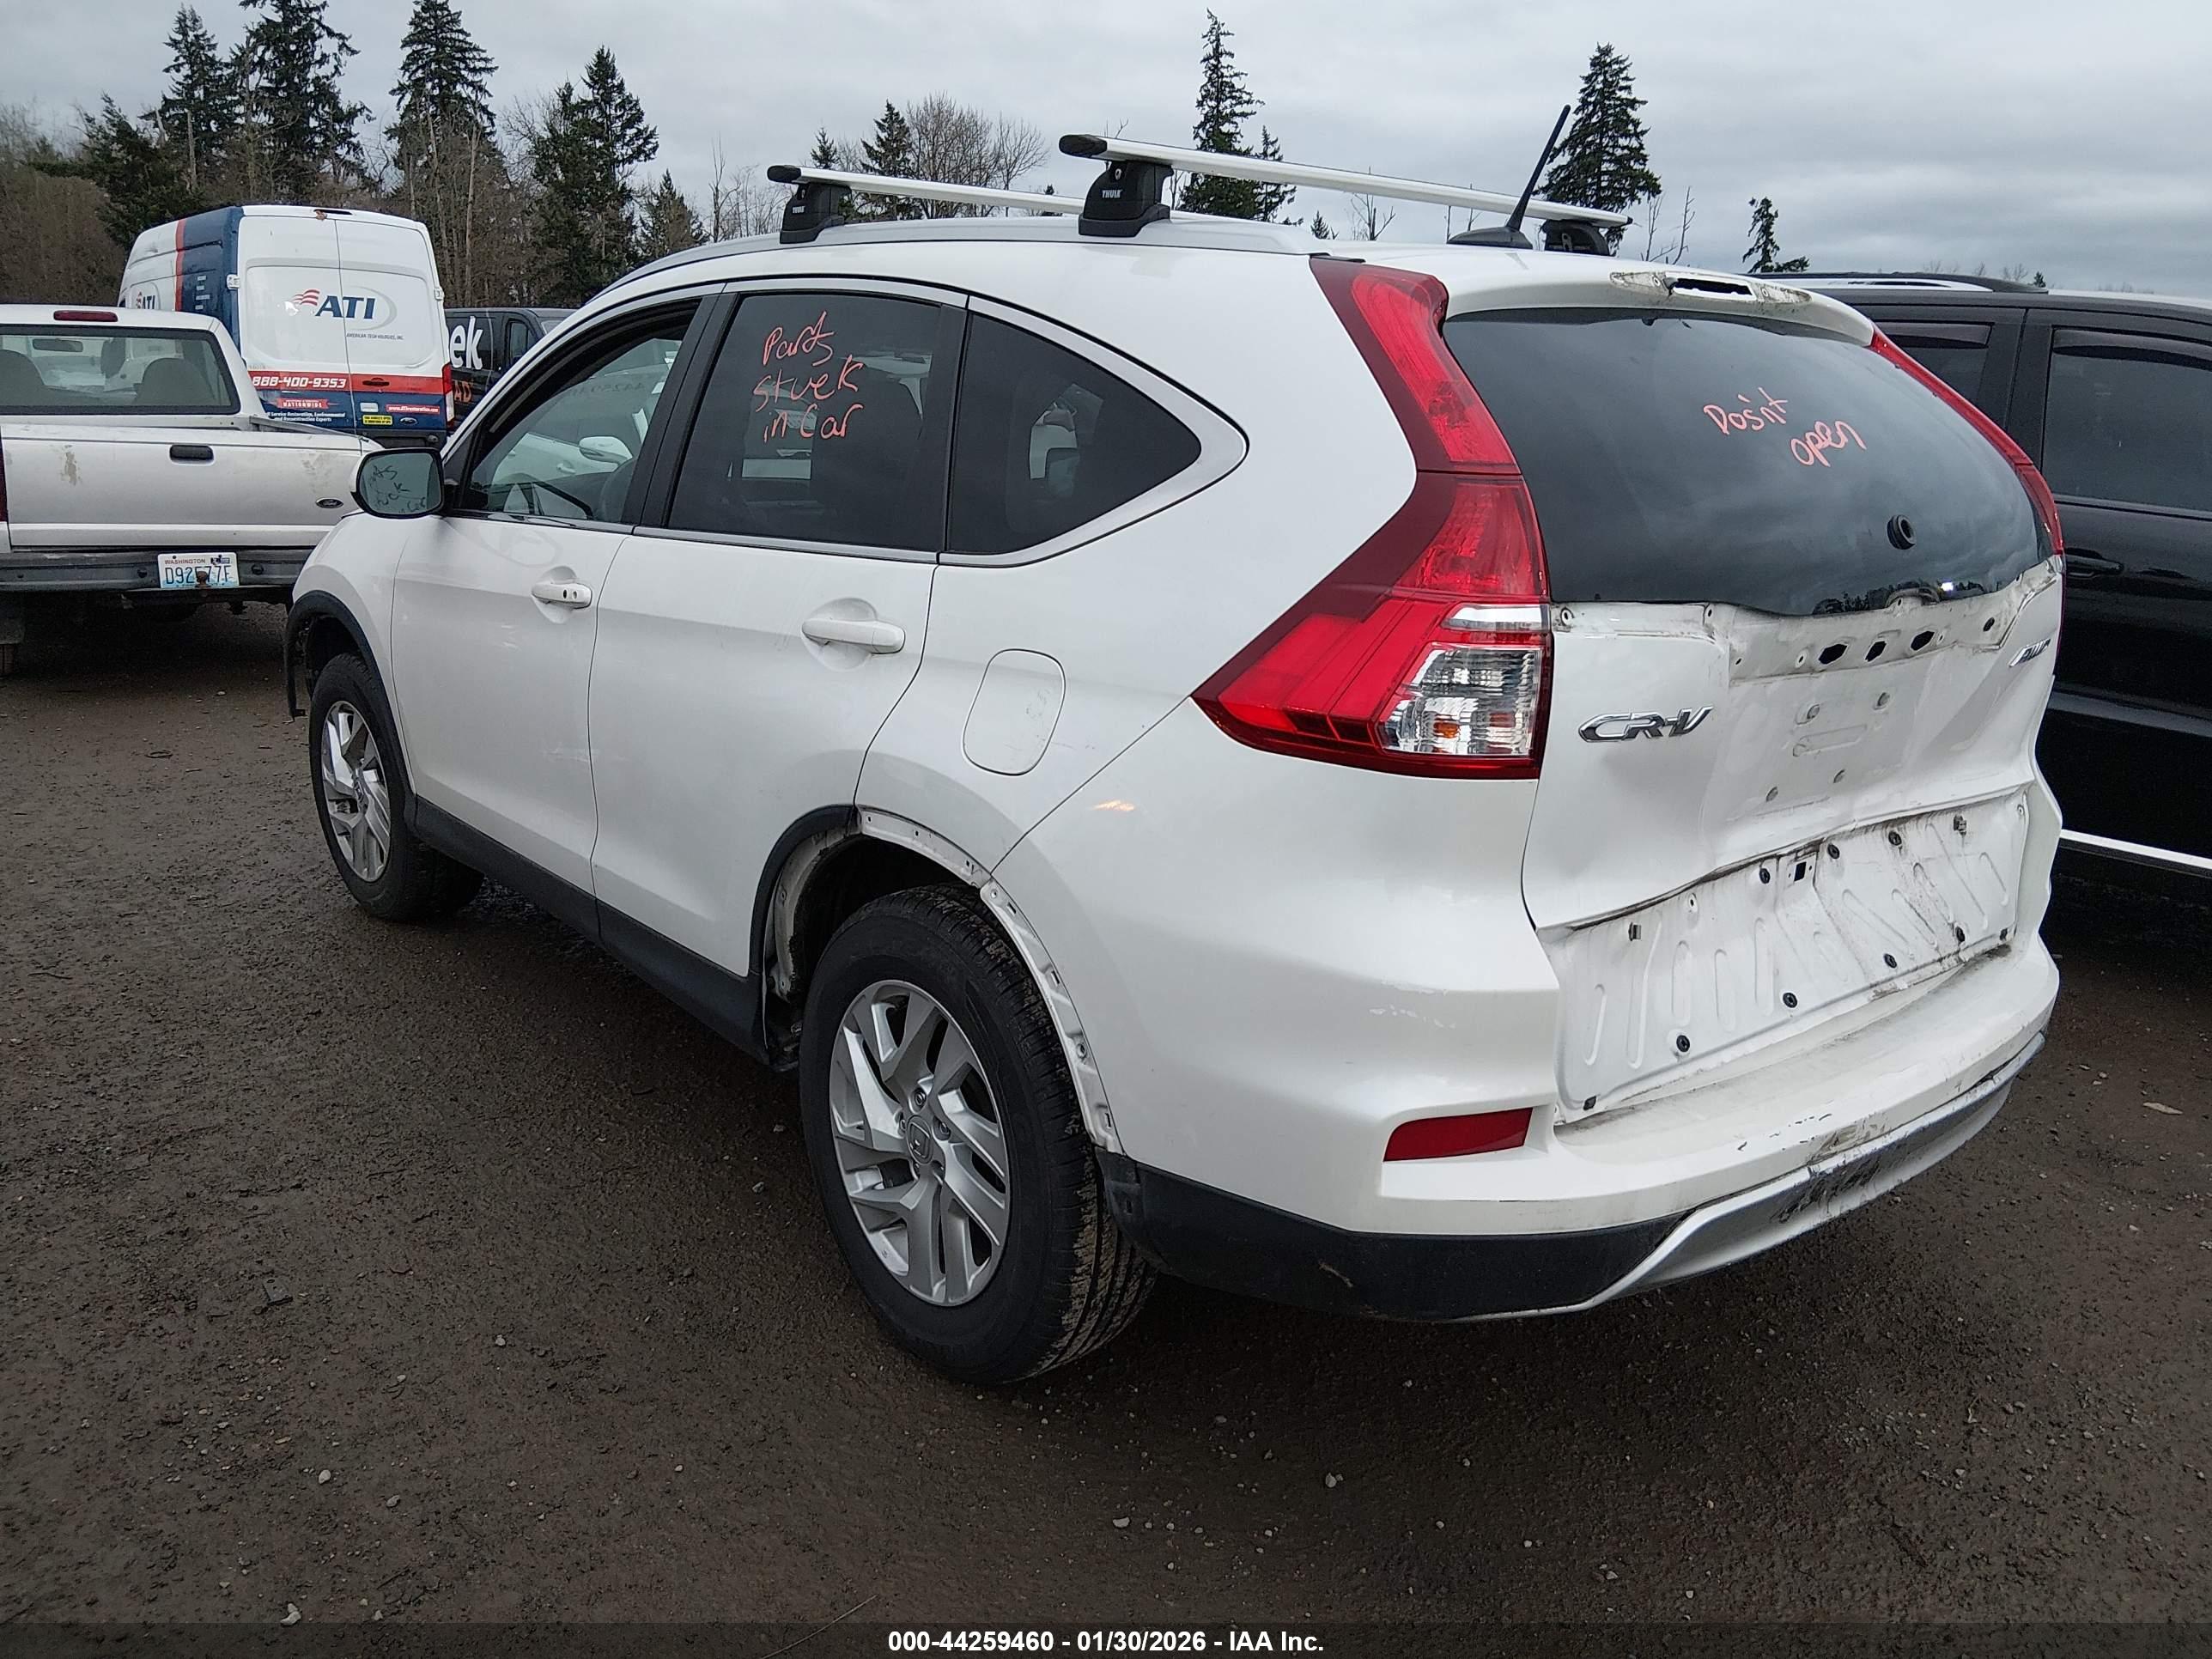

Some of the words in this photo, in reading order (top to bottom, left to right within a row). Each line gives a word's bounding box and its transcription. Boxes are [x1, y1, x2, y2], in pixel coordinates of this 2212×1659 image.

[1102, 189, 1122, 199] THULE
[314, 295, 376, 319] ATI
[252, 376, 347, 388] 888-400-9353
[763, 411, 787, 443] in
[1577, 706, 1715, 743] CR-V
